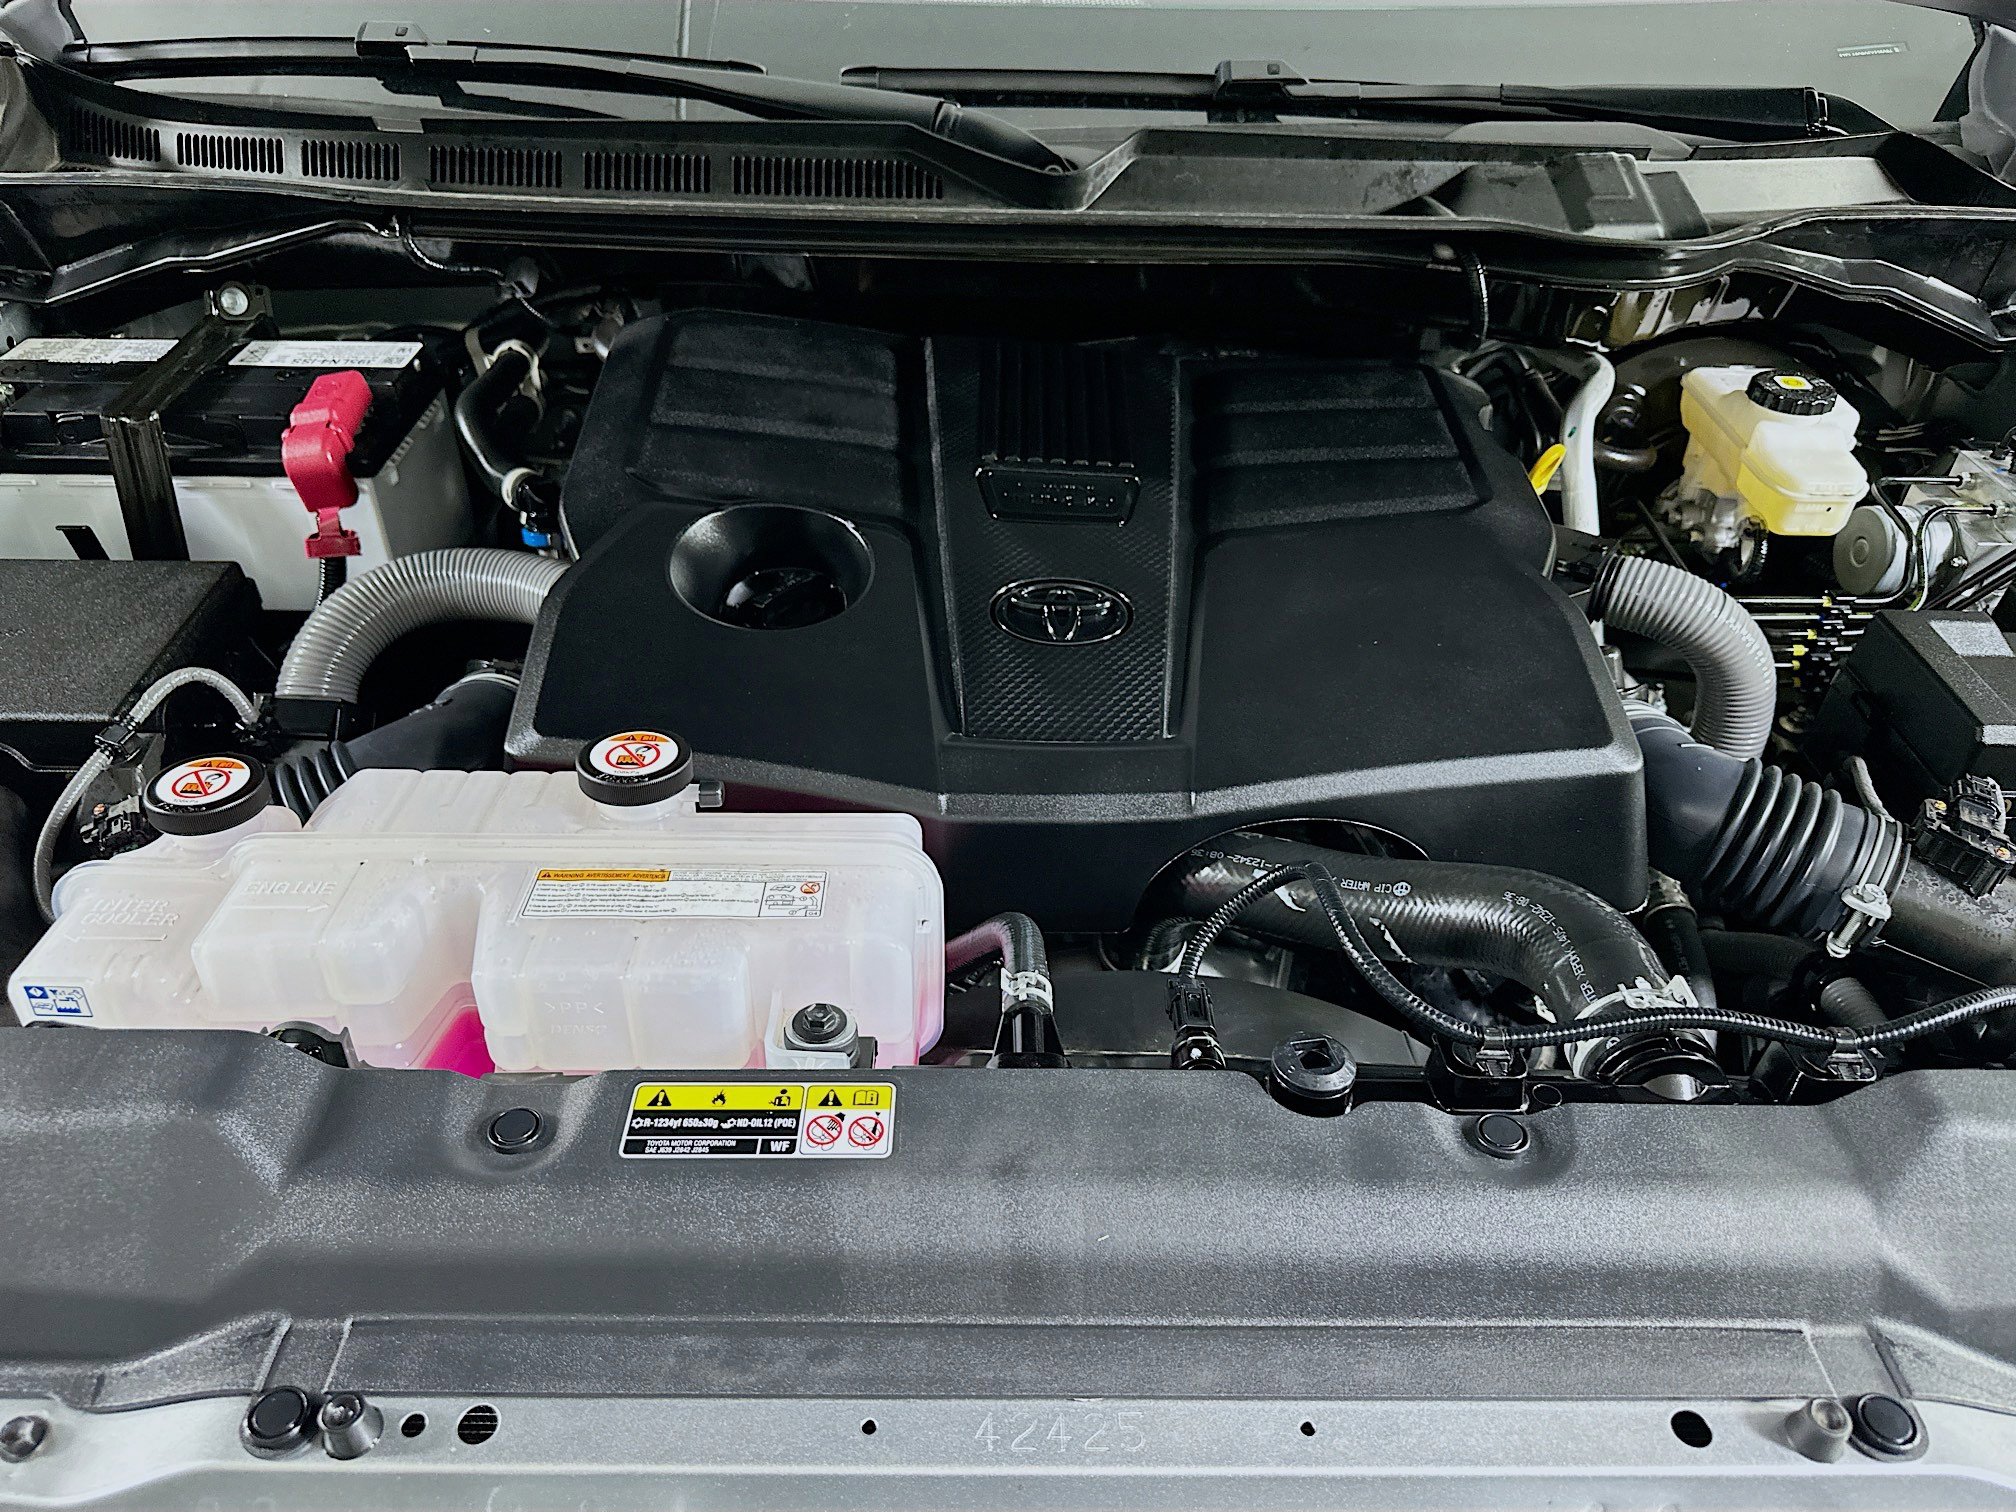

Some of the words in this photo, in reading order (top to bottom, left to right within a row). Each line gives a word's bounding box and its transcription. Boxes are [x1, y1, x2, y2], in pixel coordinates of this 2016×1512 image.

[244, 880, 338, 895] ENGINE
[1340, 878, 1370, 891] WATER
[1373, 882, 1393, 893] CIP
[90, 898, 170, 912] INTER
[80, 911, 181, 927] COOLER
[644, 1118, 681, 1129] R-1234yf
[682, 1118, 719, 1130] 650±30g
[774, 1118, 796, 1129] (POE)
[770, 1141, 790, 1152] WF
[975, 1411, 1147, 1453] 42425
